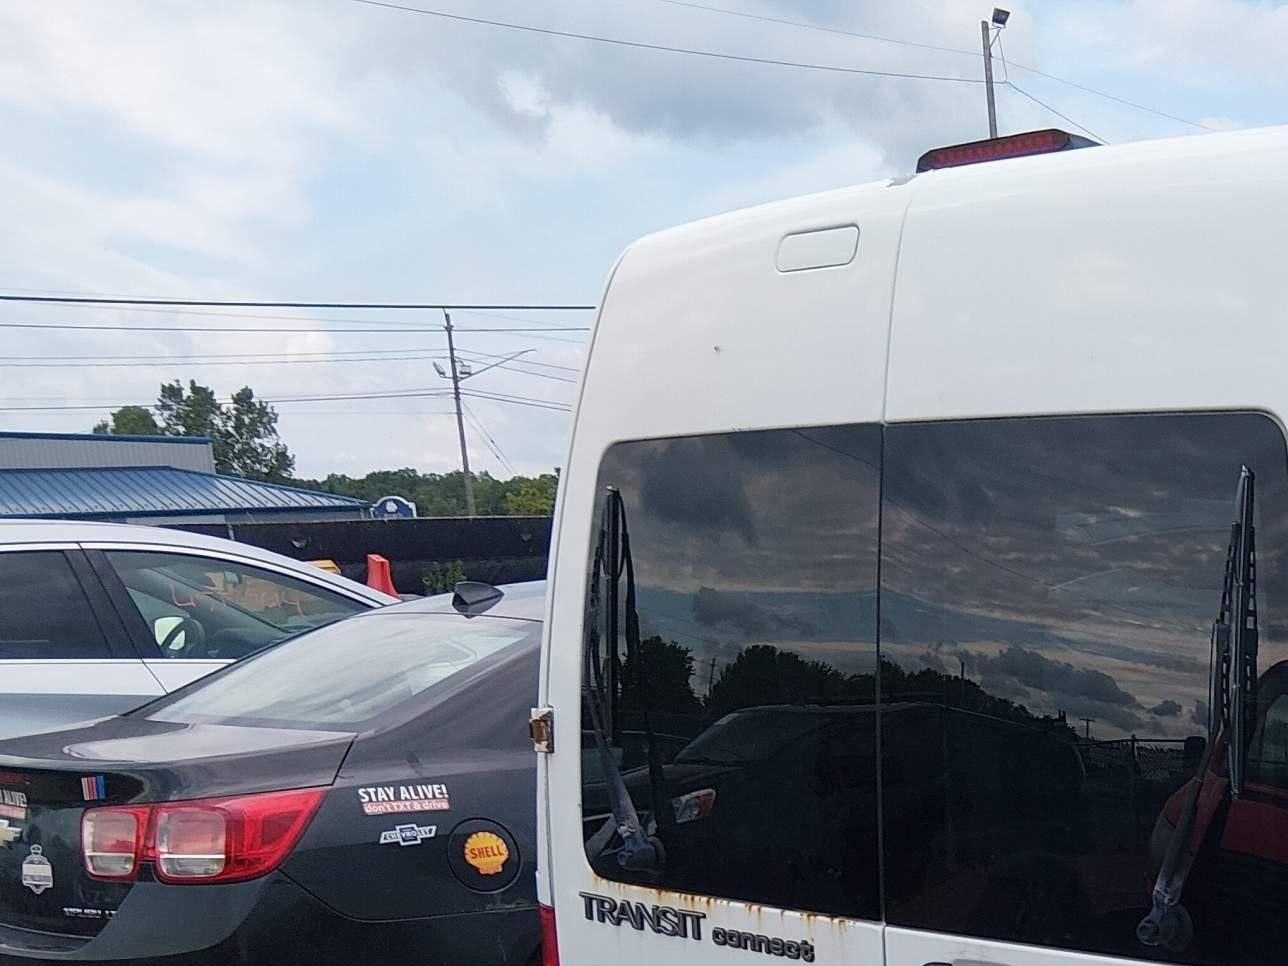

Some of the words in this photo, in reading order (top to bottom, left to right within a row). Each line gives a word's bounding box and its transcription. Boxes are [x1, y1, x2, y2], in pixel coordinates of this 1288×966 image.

[358, 787, 395, 802] STAY
[399, 784, 449, 801] ALIVE!
[470, 845, 504, 860] SHELL
[579, 891, 706, 940] TRANSIT
[712, 927, 815, 963] connect
